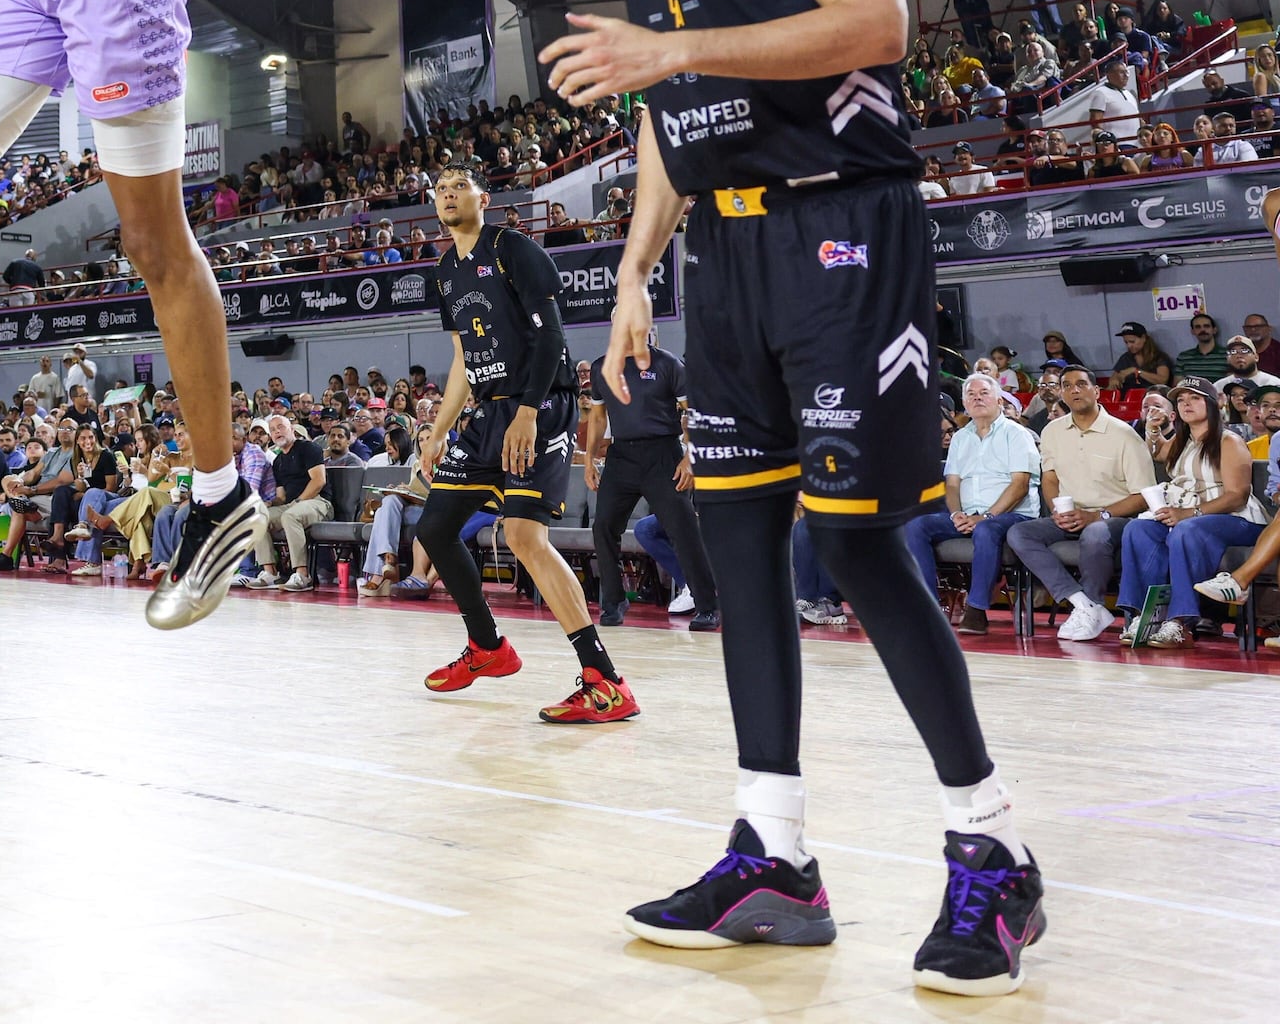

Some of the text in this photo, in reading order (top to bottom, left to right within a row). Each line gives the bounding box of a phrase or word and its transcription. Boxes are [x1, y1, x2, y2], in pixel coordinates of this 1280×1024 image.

[450, 47, 477, 62] Bank
[714, 119, 754, 135] UNION
[183, 151, 219, 176] MESEROS
[1165, 200, 1225, 217] CELSIUS
[1056, 210, 1125, 230] BETMGM
[400, 280, 423, 290] Viktor
[559, 262, 665, 293] PREMR
[305, 292, 347, 311] Tropiko
[403, 289, 422, 299] Pollo
[566, 297, 604, 308] Insurance
[1156, 295, 1199, 311] 10-H
[53, 315, 86, 328] PREMIER
[801, 408, 862, 422] FERRIES
